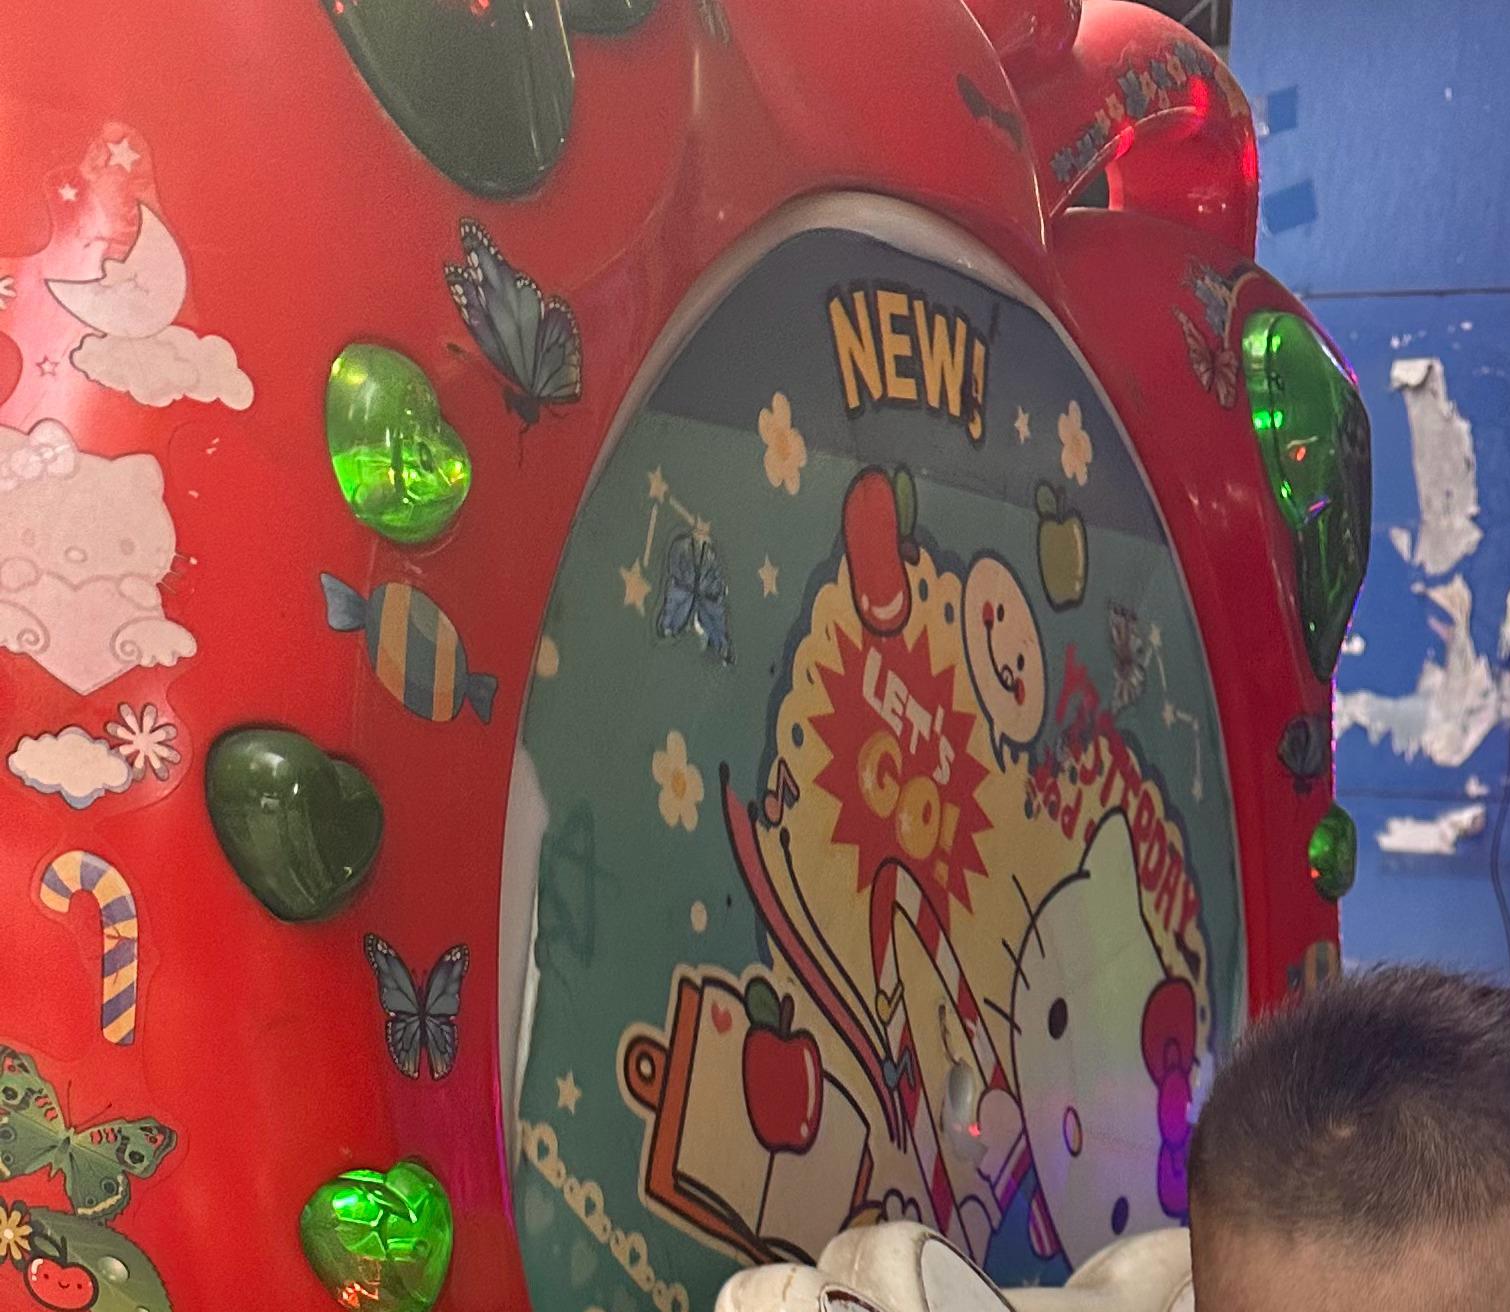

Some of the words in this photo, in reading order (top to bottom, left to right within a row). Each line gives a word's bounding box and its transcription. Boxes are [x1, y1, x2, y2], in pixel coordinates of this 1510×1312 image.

[828, 284, 985, 446] NEW!
[862, 646, 956, 785] LET'S
[857, 730, 961, 889] GO!
